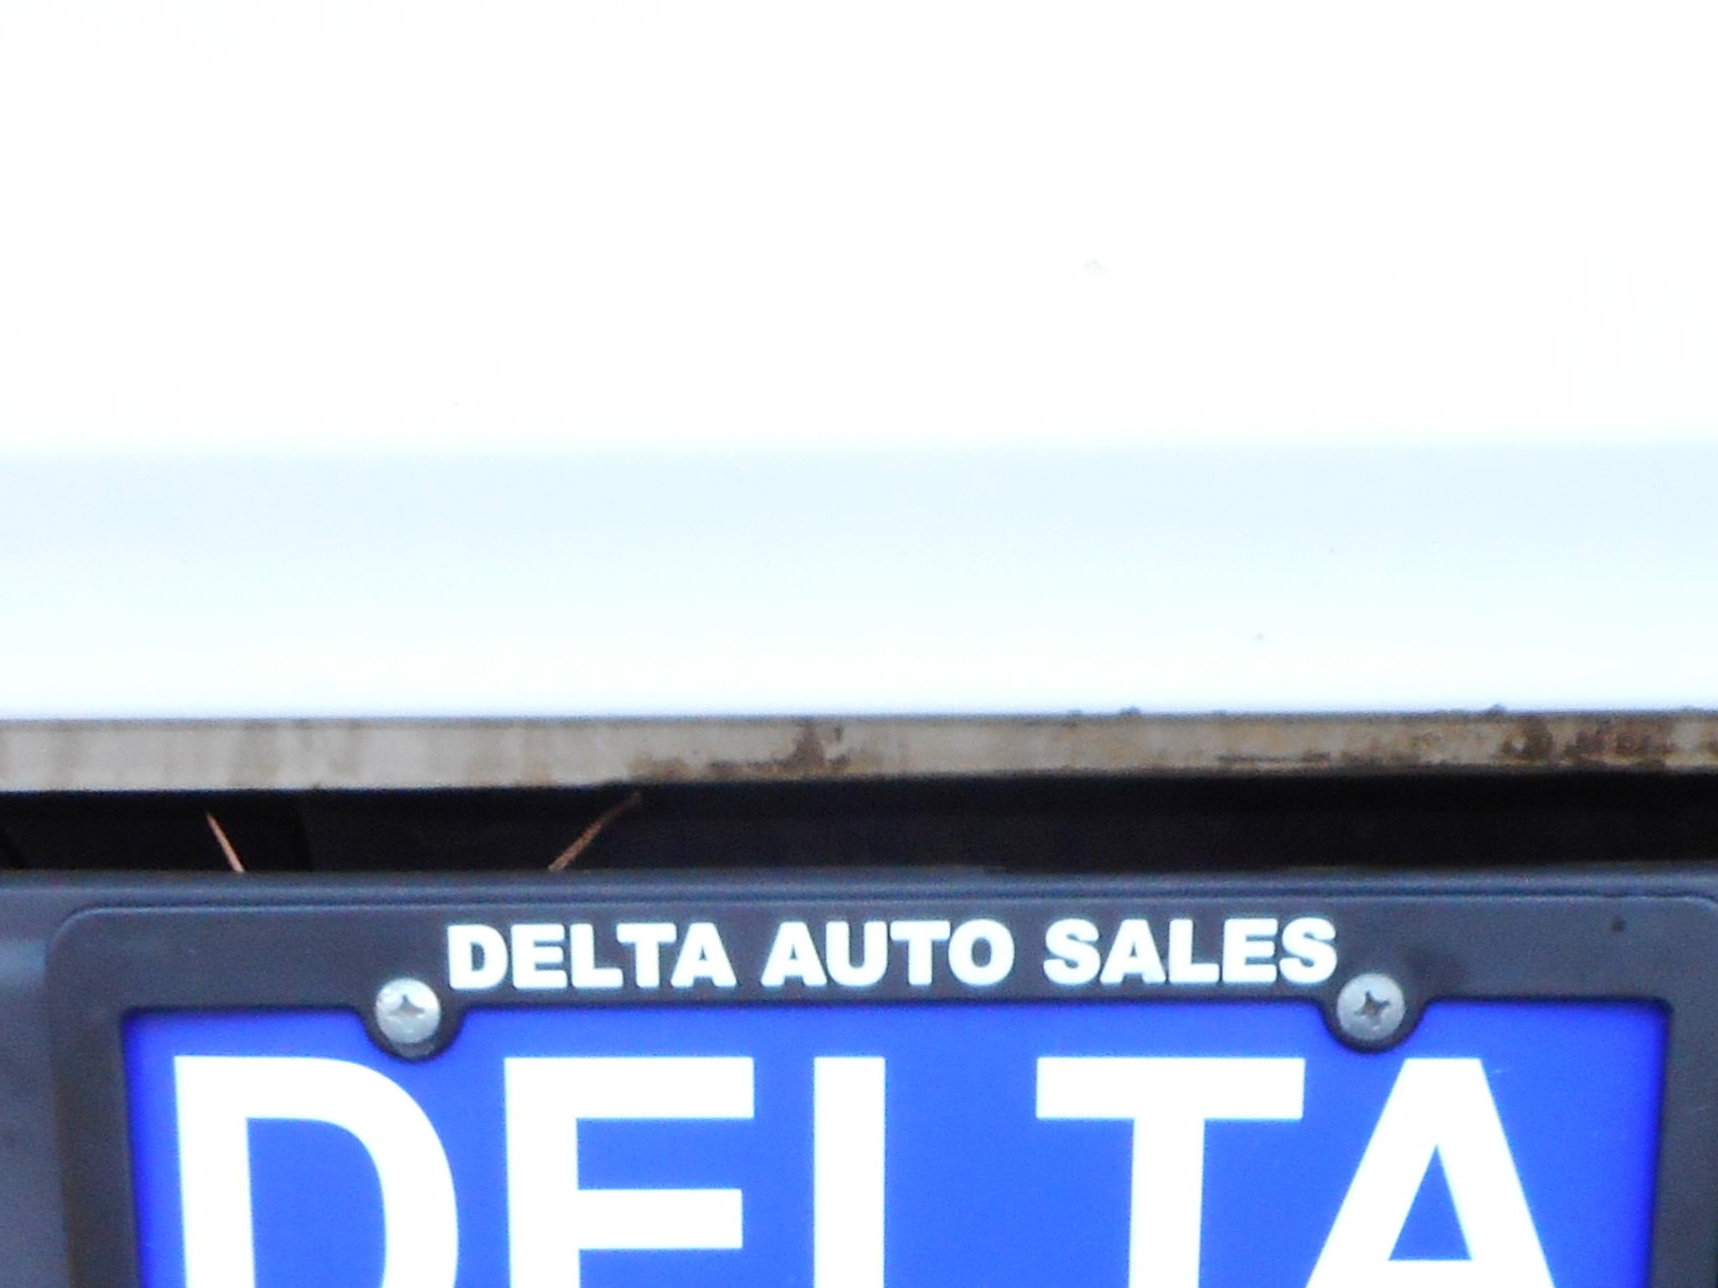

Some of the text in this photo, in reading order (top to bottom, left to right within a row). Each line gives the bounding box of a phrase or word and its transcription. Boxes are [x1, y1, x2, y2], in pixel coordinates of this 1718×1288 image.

[447, 916, 1338, 990] DELTA AUTO SALES
